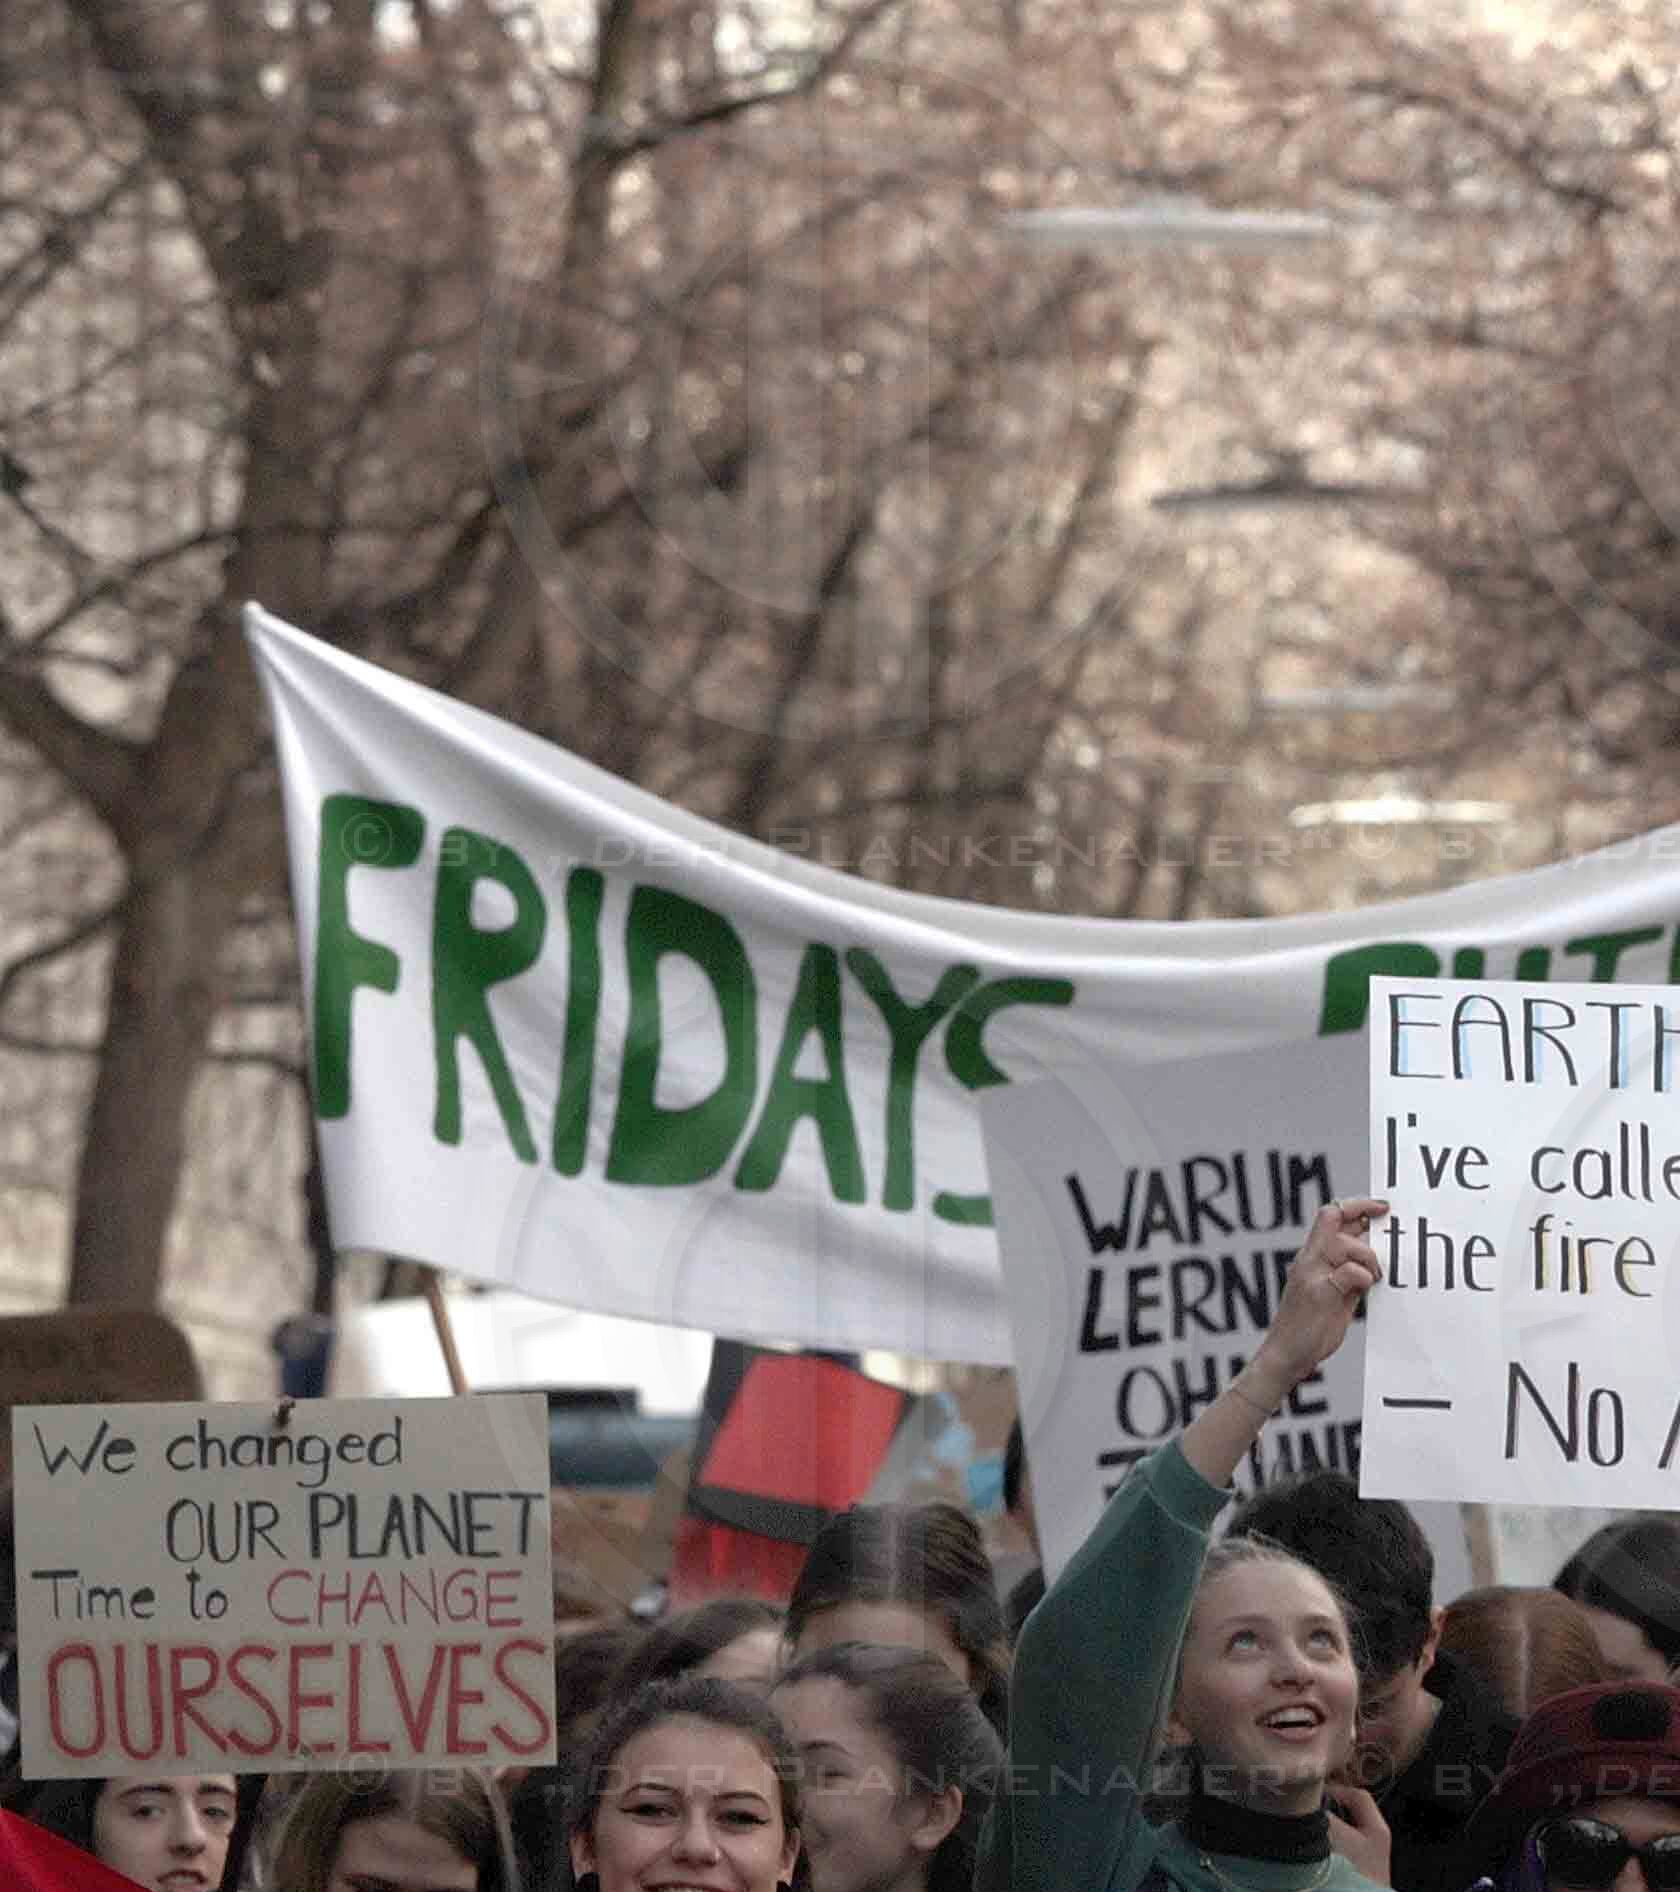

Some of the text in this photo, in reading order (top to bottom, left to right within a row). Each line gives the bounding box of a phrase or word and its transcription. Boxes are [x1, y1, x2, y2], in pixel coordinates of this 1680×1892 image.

[1385, 1115, 1492, 1192] I've
[1066, 1149, 1334, 1255] WARUM
[1383, 1217, 1496, 1294] the
[1529, 1214, 1658, 1299] fire
[1079, 1248, 1367, 1354] LERN
[1115, 1354, 1329, 1440] OHE
[1505, 1361, 1626, 1468] No
[33, 1416, 402, 1488] We changed
[166, 1492, 546, 1563] OUR PLANET
[31, 1568, 523, 1630] Time to CHANGE
[47, 1639, 552, 1761] OURSELVES
